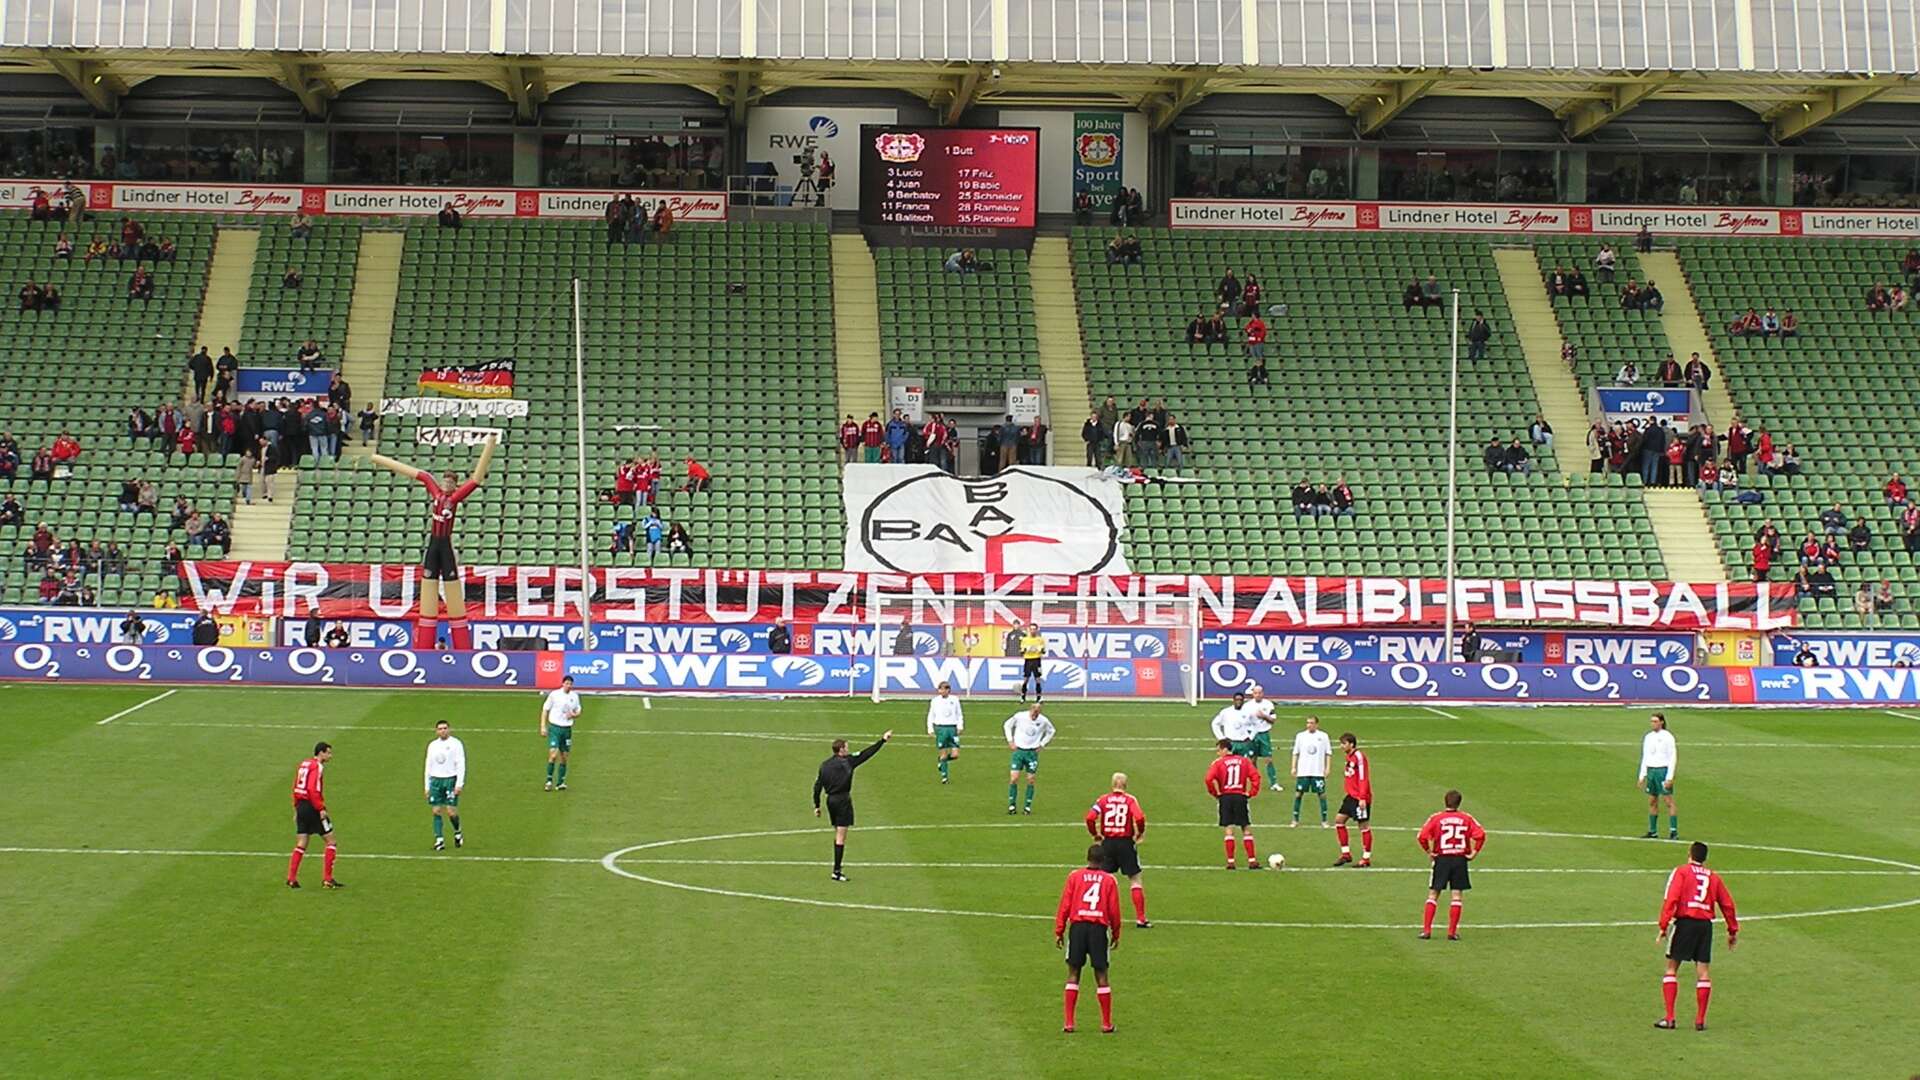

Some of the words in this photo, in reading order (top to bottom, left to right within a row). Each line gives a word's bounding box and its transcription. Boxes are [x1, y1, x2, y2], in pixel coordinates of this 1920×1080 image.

[1077, 119, 1093, 129] 100
[1095, 119, 1121, 130] Jahre
[769, 135, 819, 149] RWE
[945, 147, 950, 156] 1
[952, 147, 974, 156] Butt
[887, 169, 895, 177] 3
[896, 168, 923, 177] Lucio
[958, 169, 970, 178] 17
[972, 169, 994, 178] Fritz
[1076, 168, 1119, 184] Sport
[887, 180, 895, 189] 4
[896, 180, 921, 189] Juan
[972, 181, 1001, 191] Babic
[1091, 183, 1104, 191] bei
[121, 189, 179, 204] Lindner
[186, 190, 229, 205] Hotel
[333, 193, 393, 208] Lindner
[399, 194, 442, 209] Hotel
[547, 195, 607, 210] Lindner
[887, 191, 895, 200] 9
[896, 191, 941, 201] Berbatov
[958, 192, 972, 201] 25
[973, 192, 1024, 202] Schneider
[881, 202, 894, 211] 11
[958, 203, 971, 212] 28
[974, 203, 1021, 213] Ramelow
[1175, 205, 1236, 220] Lindner
[1241, 206, 1284, 221] Hotel
[881, 214, 894, 223] 14
[895, 213, 934, 223] Balitsch
[958, 215, 971, 224] 35
[973, 215, 1016, 225] Placente
[1388, 208, 1449, 223] Lindner
[1455, 209, 1498, 224] Hotel
[1600, 212, 1660, 227] Lindner
[1667, 212, 1707, 227] Hotel
[1812, 215, 1873, 230] Lindner
[1877, 216, 1919, 230] Hotel
[261, 381, 295, 392] RWE
[1620, 402, 1654, 412] RWE
[984, 573, 1234, 625] KEINEN
[1247, 575, 1792, 629] ALIBI-FUSSBALL
[44, 617, 126, 644] RWE
[284, 620, 376, 647] RE
[600, 629, 617, 638] RWE
[626, 627, 718, 653] RWE
[814, 629, 897, 656] RWE
[1040, 631, 1132, 659] RWE
[1228, 634, 1319, 661] RWE
[1379, 636, 1466, 663] RWE
[1566, 638, 1657, 665] RWE
[1804, 641, 1892, 667] RWE
[569, 665, 598, 674] RWE
[612, 653, 768, 687] RWE
[830, 667, 859, 678] RWE
[878, 656, 1025, 691] RWE
[1091, 672, 1120, 682] RWE
[1761, 679, 1792, 689] RWE
[1801, 668, 1920, 700] RW
[1227, 764, 1240, 786] 11
[1104, 803, 1129, 827] 28
[1440, 825, 1468, 850] 25
[1694, 874, 1710, 903] 3
[1083, 882, 1101, 911] 4
